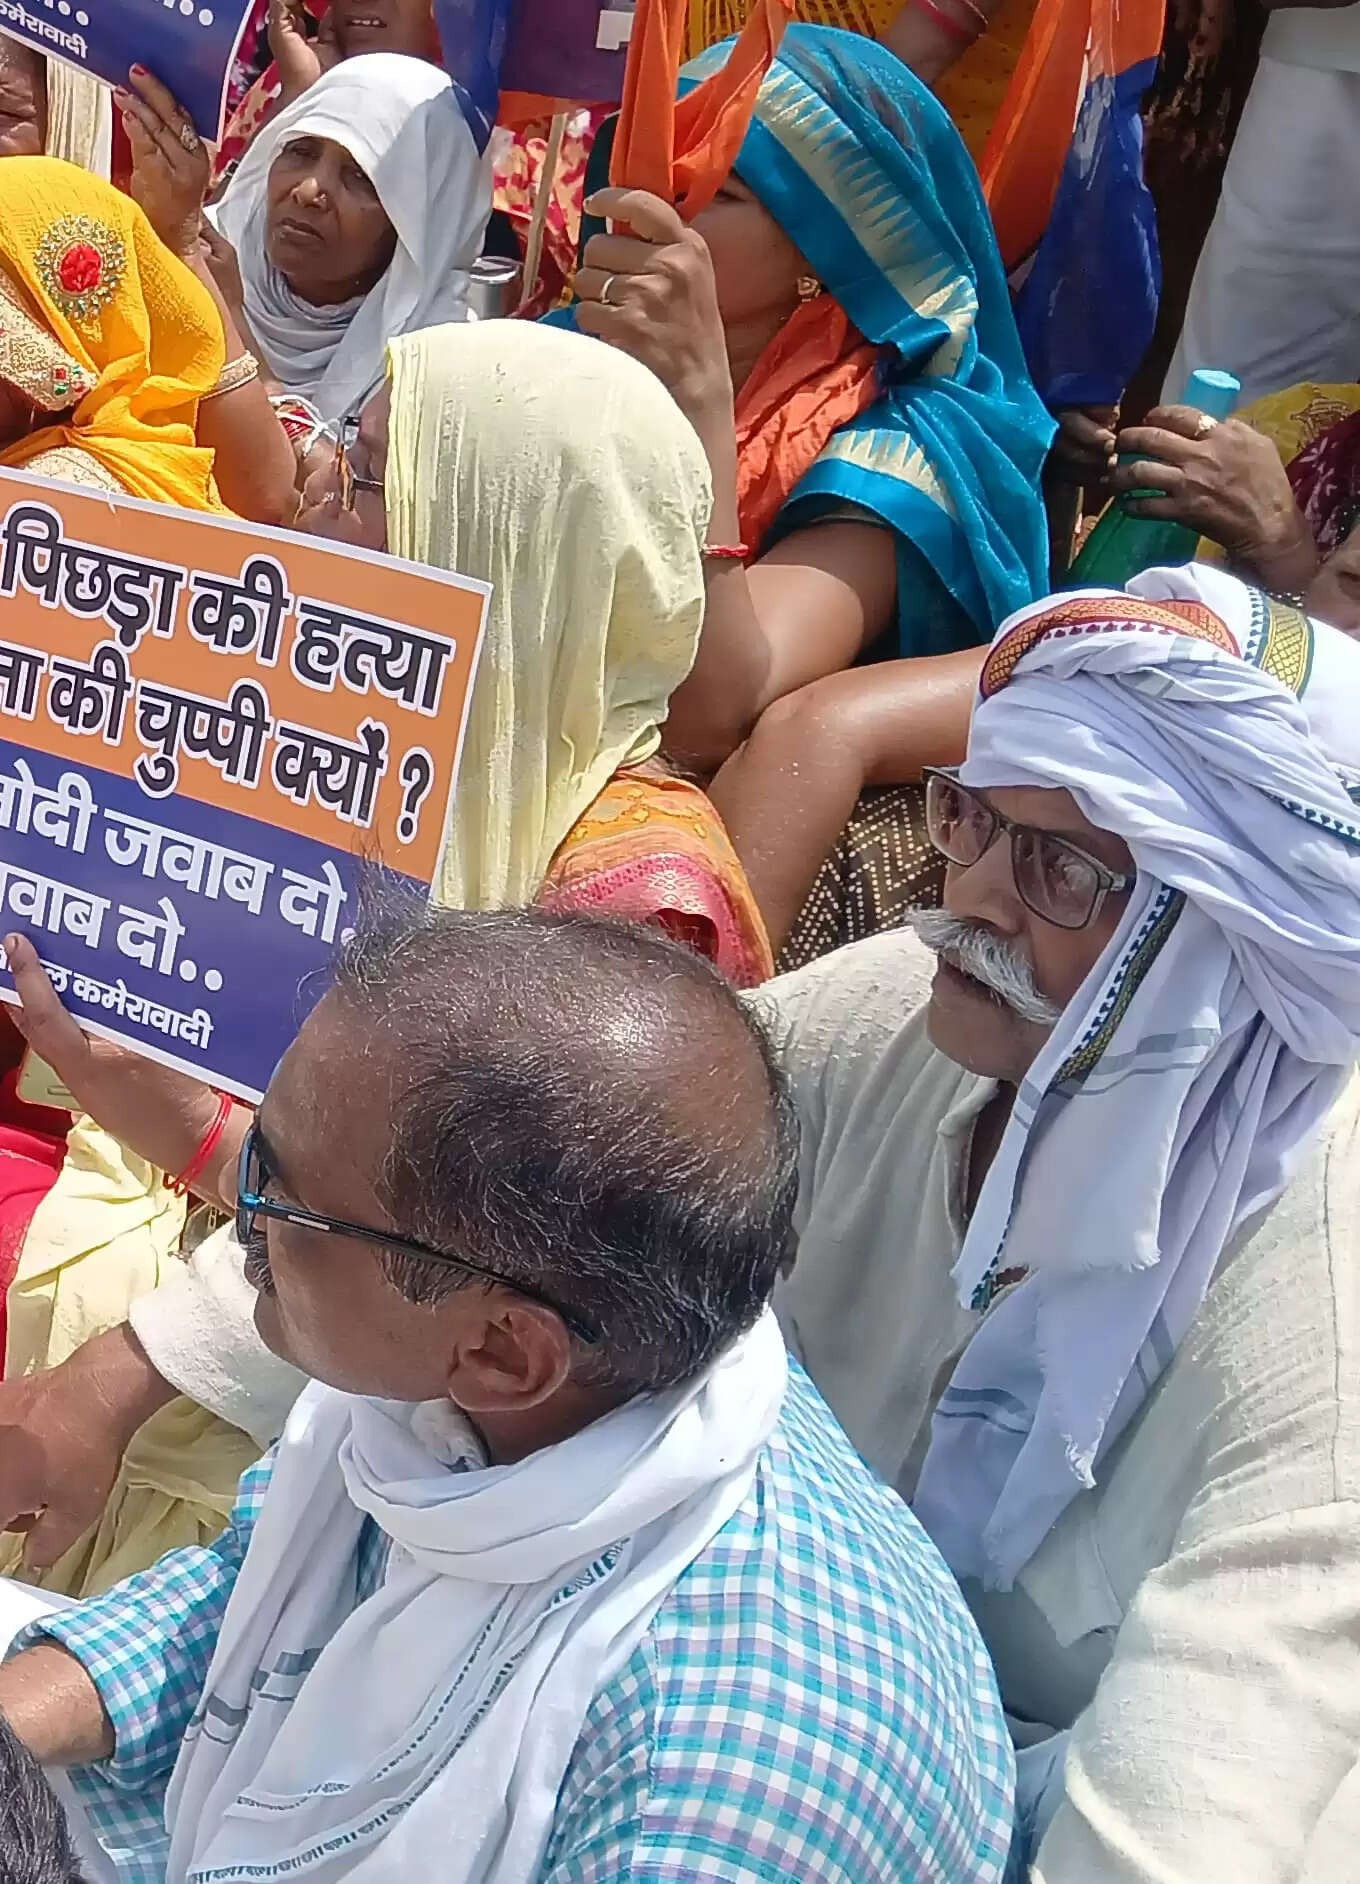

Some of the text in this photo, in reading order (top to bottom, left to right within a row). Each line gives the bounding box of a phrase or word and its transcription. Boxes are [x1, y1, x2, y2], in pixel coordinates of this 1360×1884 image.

[0, 501, 186, 650] पिछड़ा
[190, 554, 293, 666] की
[294, 597, 456, 716] हत्या
[48, 642, 130, 744] की
[135, 679, 273, 795] चुप्पी
[272, 719, 391, 827] क्यों
[397, 745, 435, 843] ?
[104, 811, 276, 915] जवाब
[72, 972, 214, 1049] कमेरावादी
